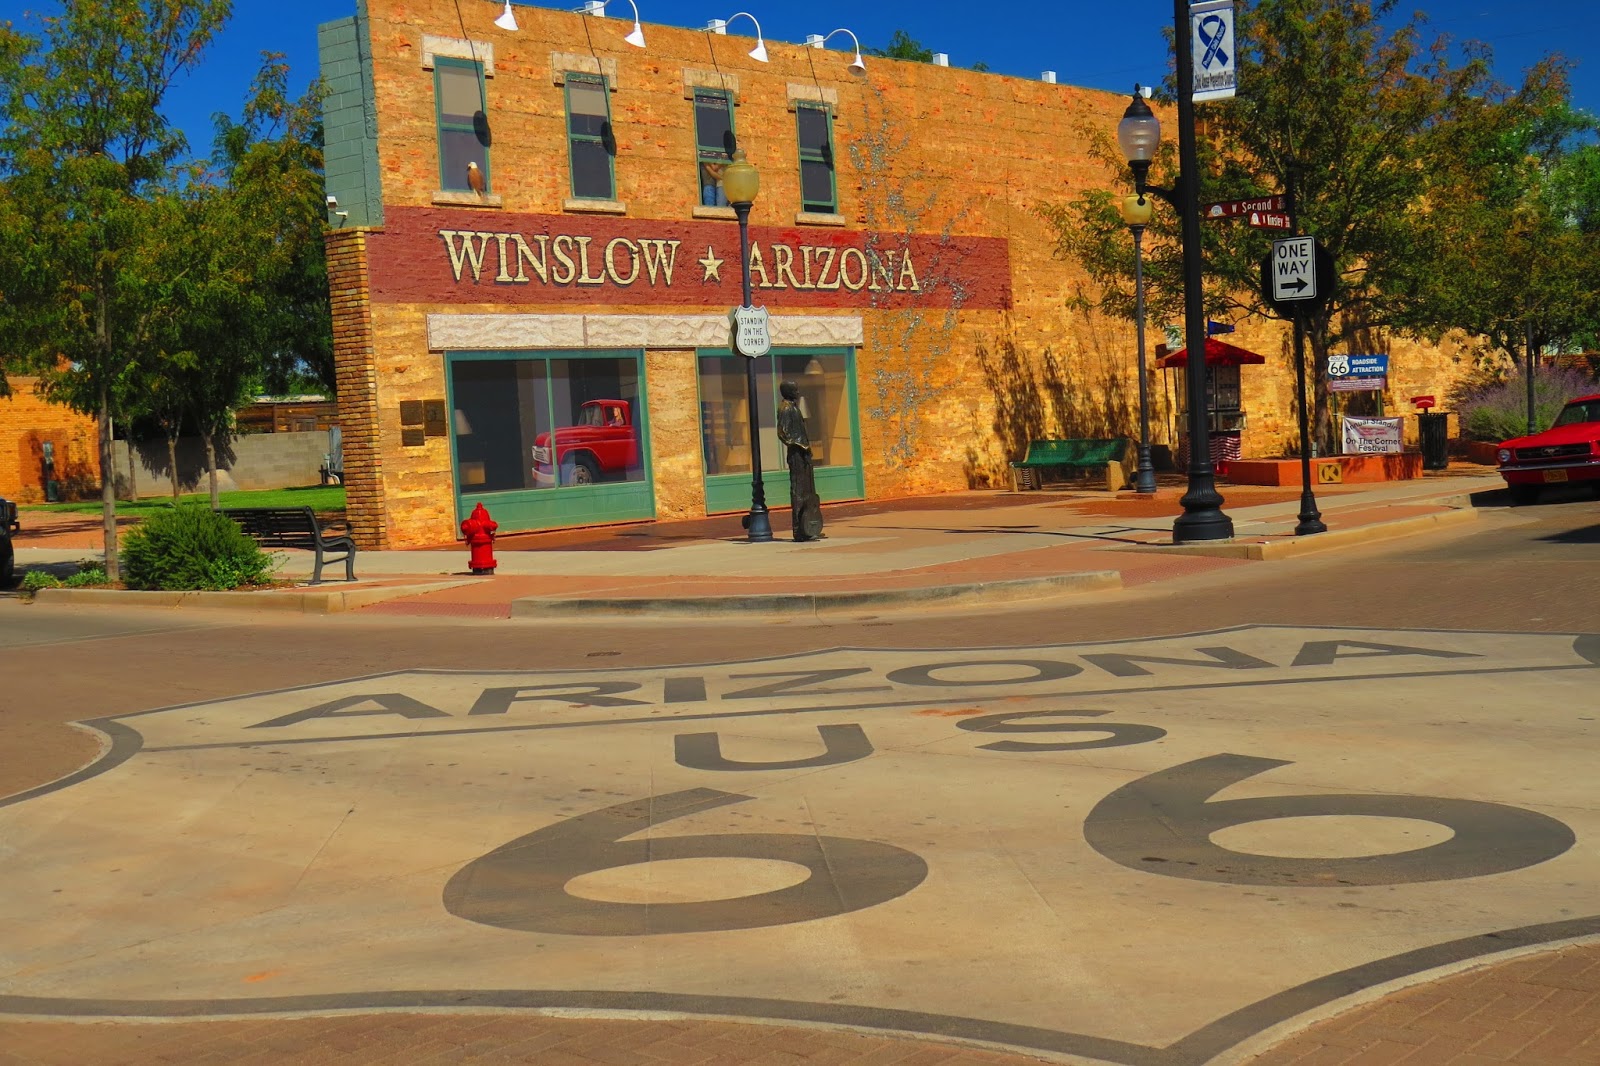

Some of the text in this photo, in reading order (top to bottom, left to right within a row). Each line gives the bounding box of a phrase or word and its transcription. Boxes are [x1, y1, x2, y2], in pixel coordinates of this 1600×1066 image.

[1231, 204, 1238, 213] W
[1241, 199, 1272, 213] Second
[1278, 243, 1308, 259] ONE
[439, 230, 921, 292] WINSLOW ARIZONA
[1278, 260, 1309, 275] WAY
[744, 328, 763, 336] ON THE
[743, 338, 765, 346] CORNER
[1330, 362, 1347, 374] 66
[1345, 437, 1401, 445] On The Corner
[242, 639, 1486, 729] ARIZONA
[674, 709, 1168, 771] US
[442, 753, 1576, 936] 66
